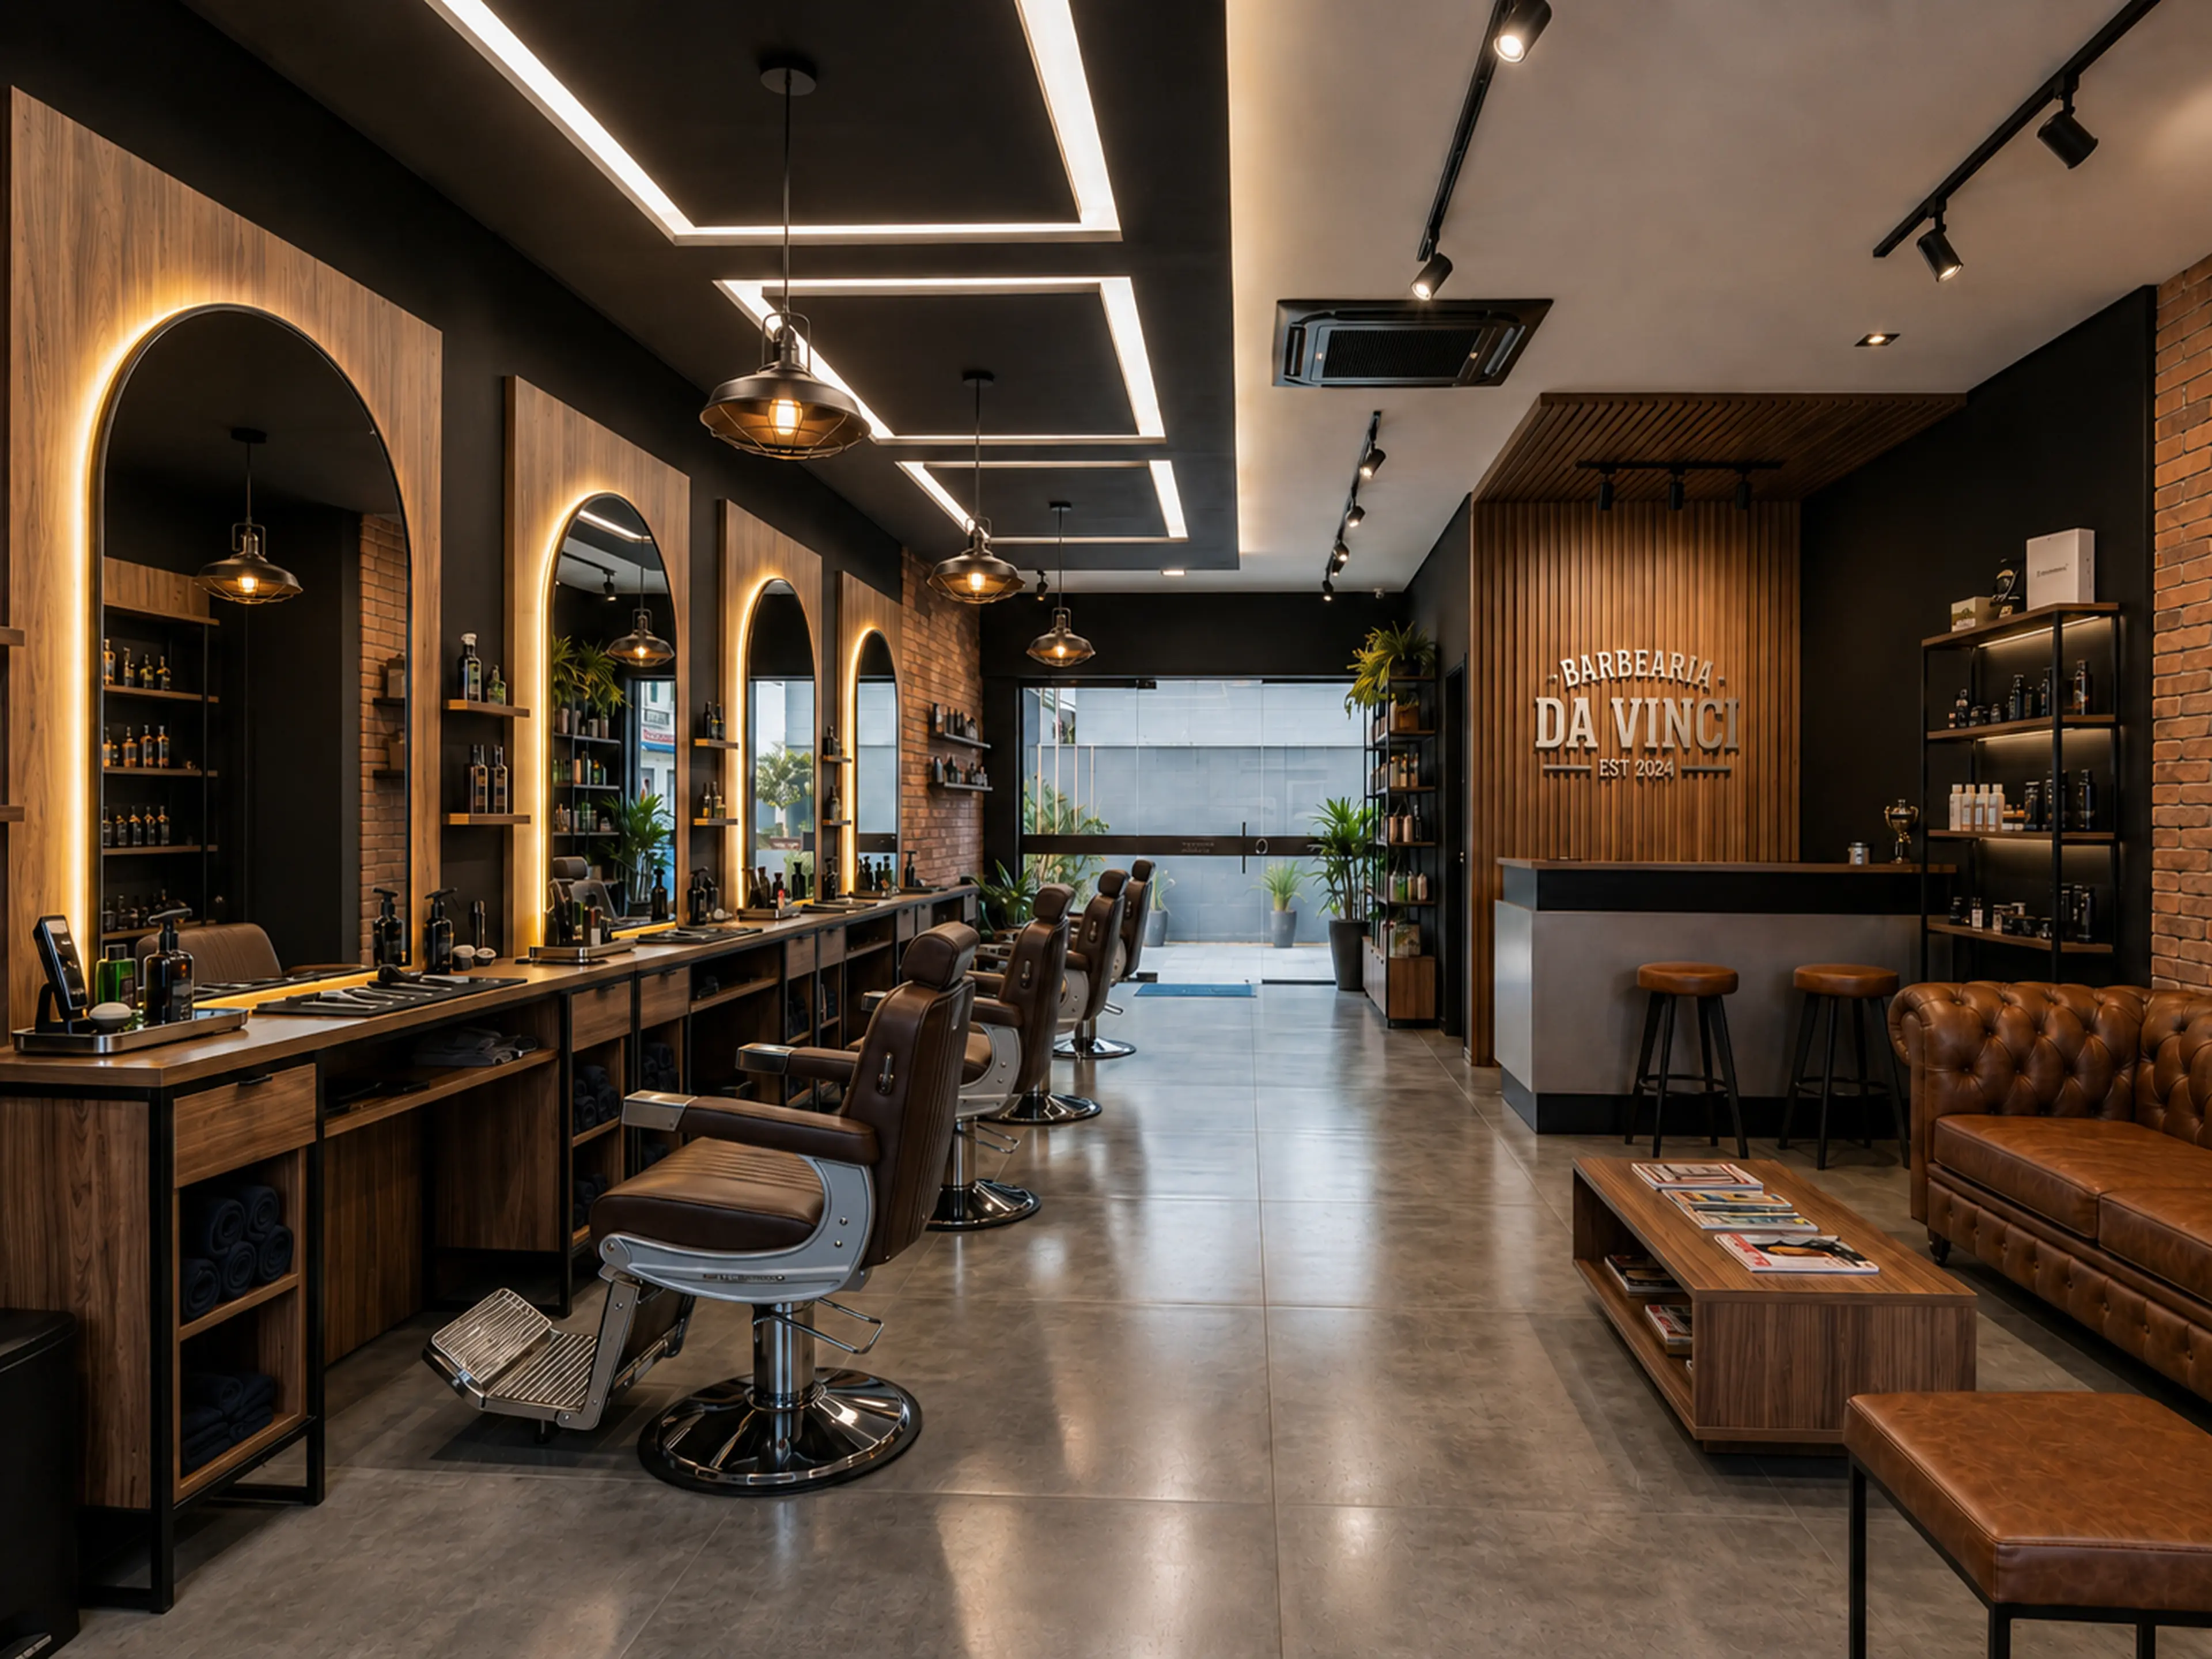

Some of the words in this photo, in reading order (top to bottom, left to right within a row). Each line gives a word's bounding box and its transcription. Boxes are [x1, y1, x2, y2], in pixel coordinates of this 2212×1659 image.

[1559, 649, 1713, 688] BARBEARIA
[1535, 697, 1598, 748] DA
[1611, 697, 1739, 749] VINCI
[1599, 759, 1630, 777] EST
[1635, 758, 1674, 777] 2024
